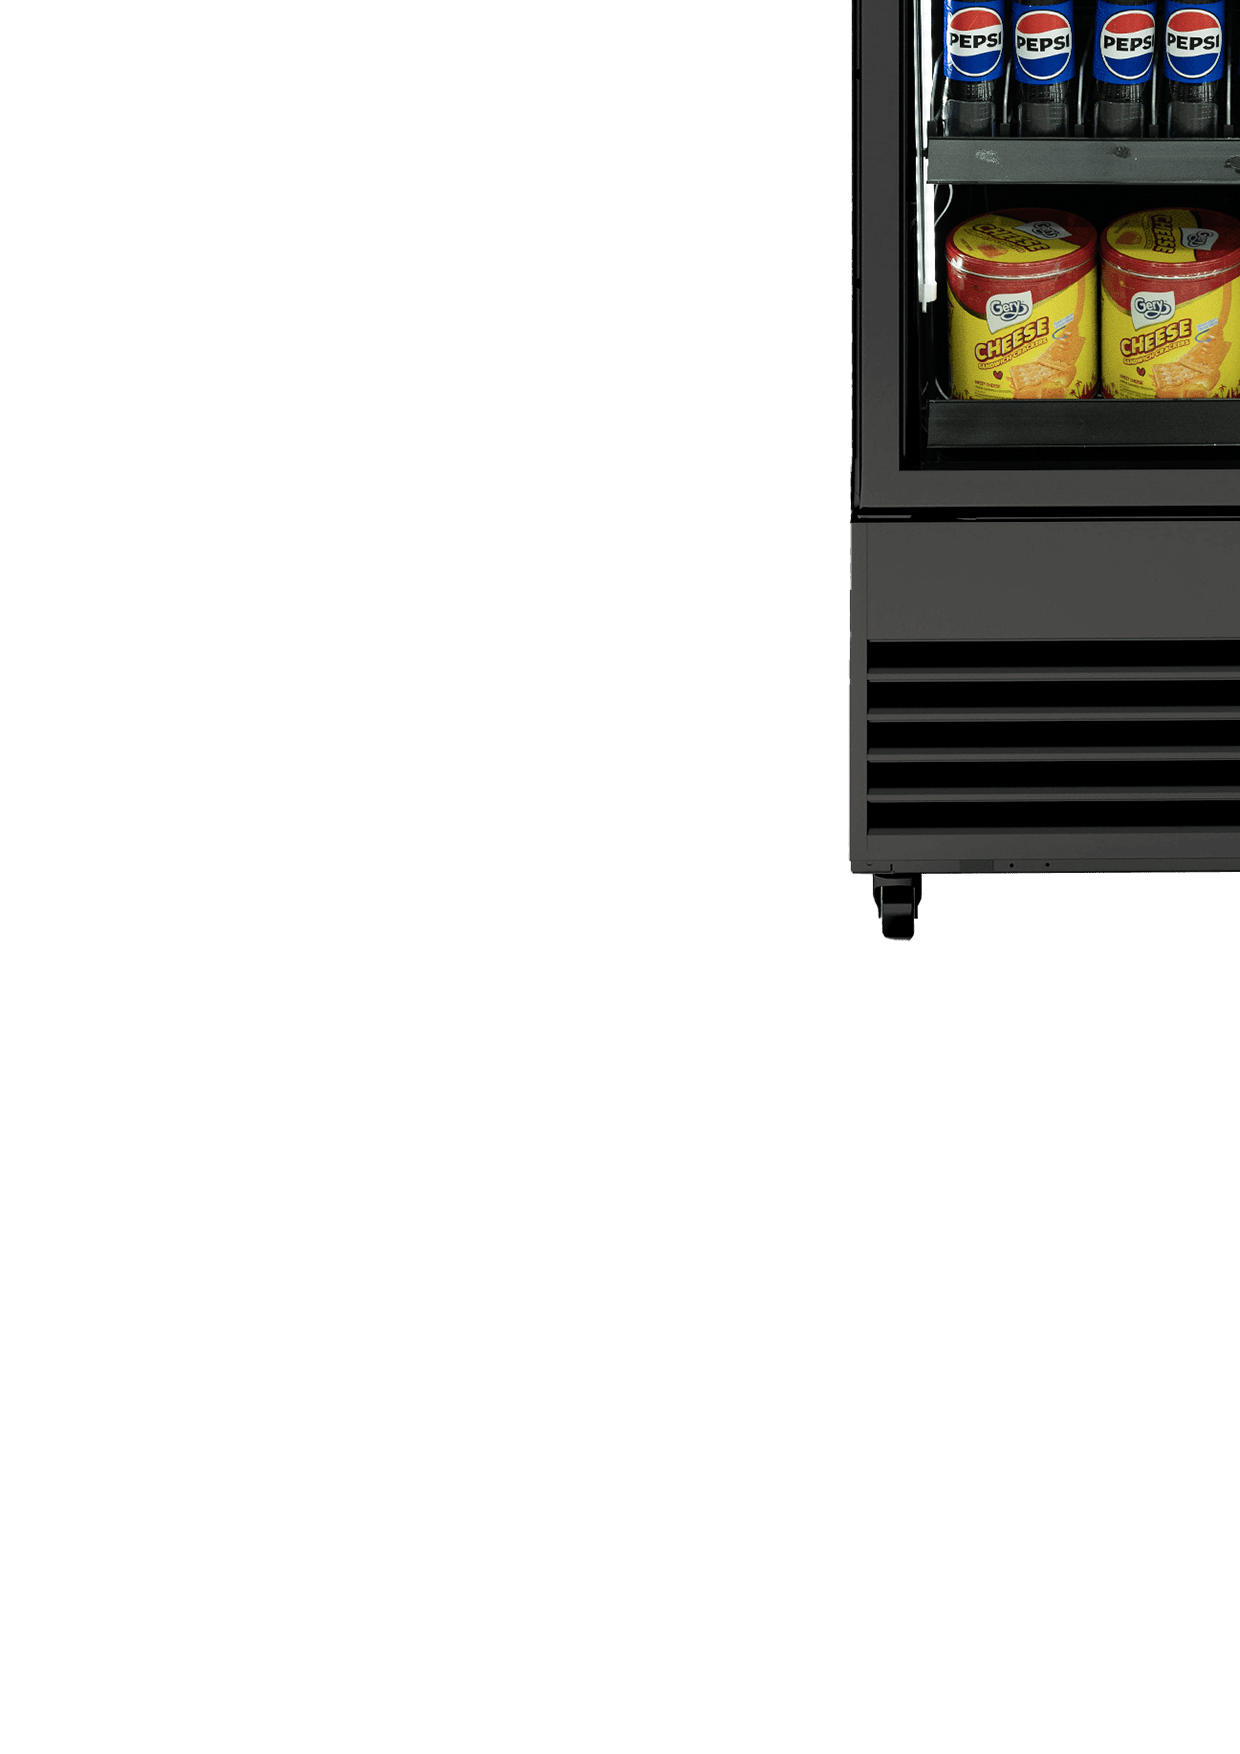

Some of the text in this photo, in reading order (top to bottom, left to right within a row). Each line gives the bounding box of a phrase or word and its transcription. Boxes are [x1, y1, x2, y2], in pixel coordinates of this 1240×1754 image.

[1016, 34, 1070, 52] PEPSI
[1167, 33, 1220, 50] PEPSI
[1150, 214, 1176, 254] CHEESE
[989, 299, 1029, 322] Gery
[1135, 297, 1172, 320] Gery
[974, 316, 1050, 363] CHEESE
[1119, 318, 1192, 358] CHEESE
[978, 354, 1013, 370] SANDWICH
[1122, 352, 1154, 366] SANDWICH
